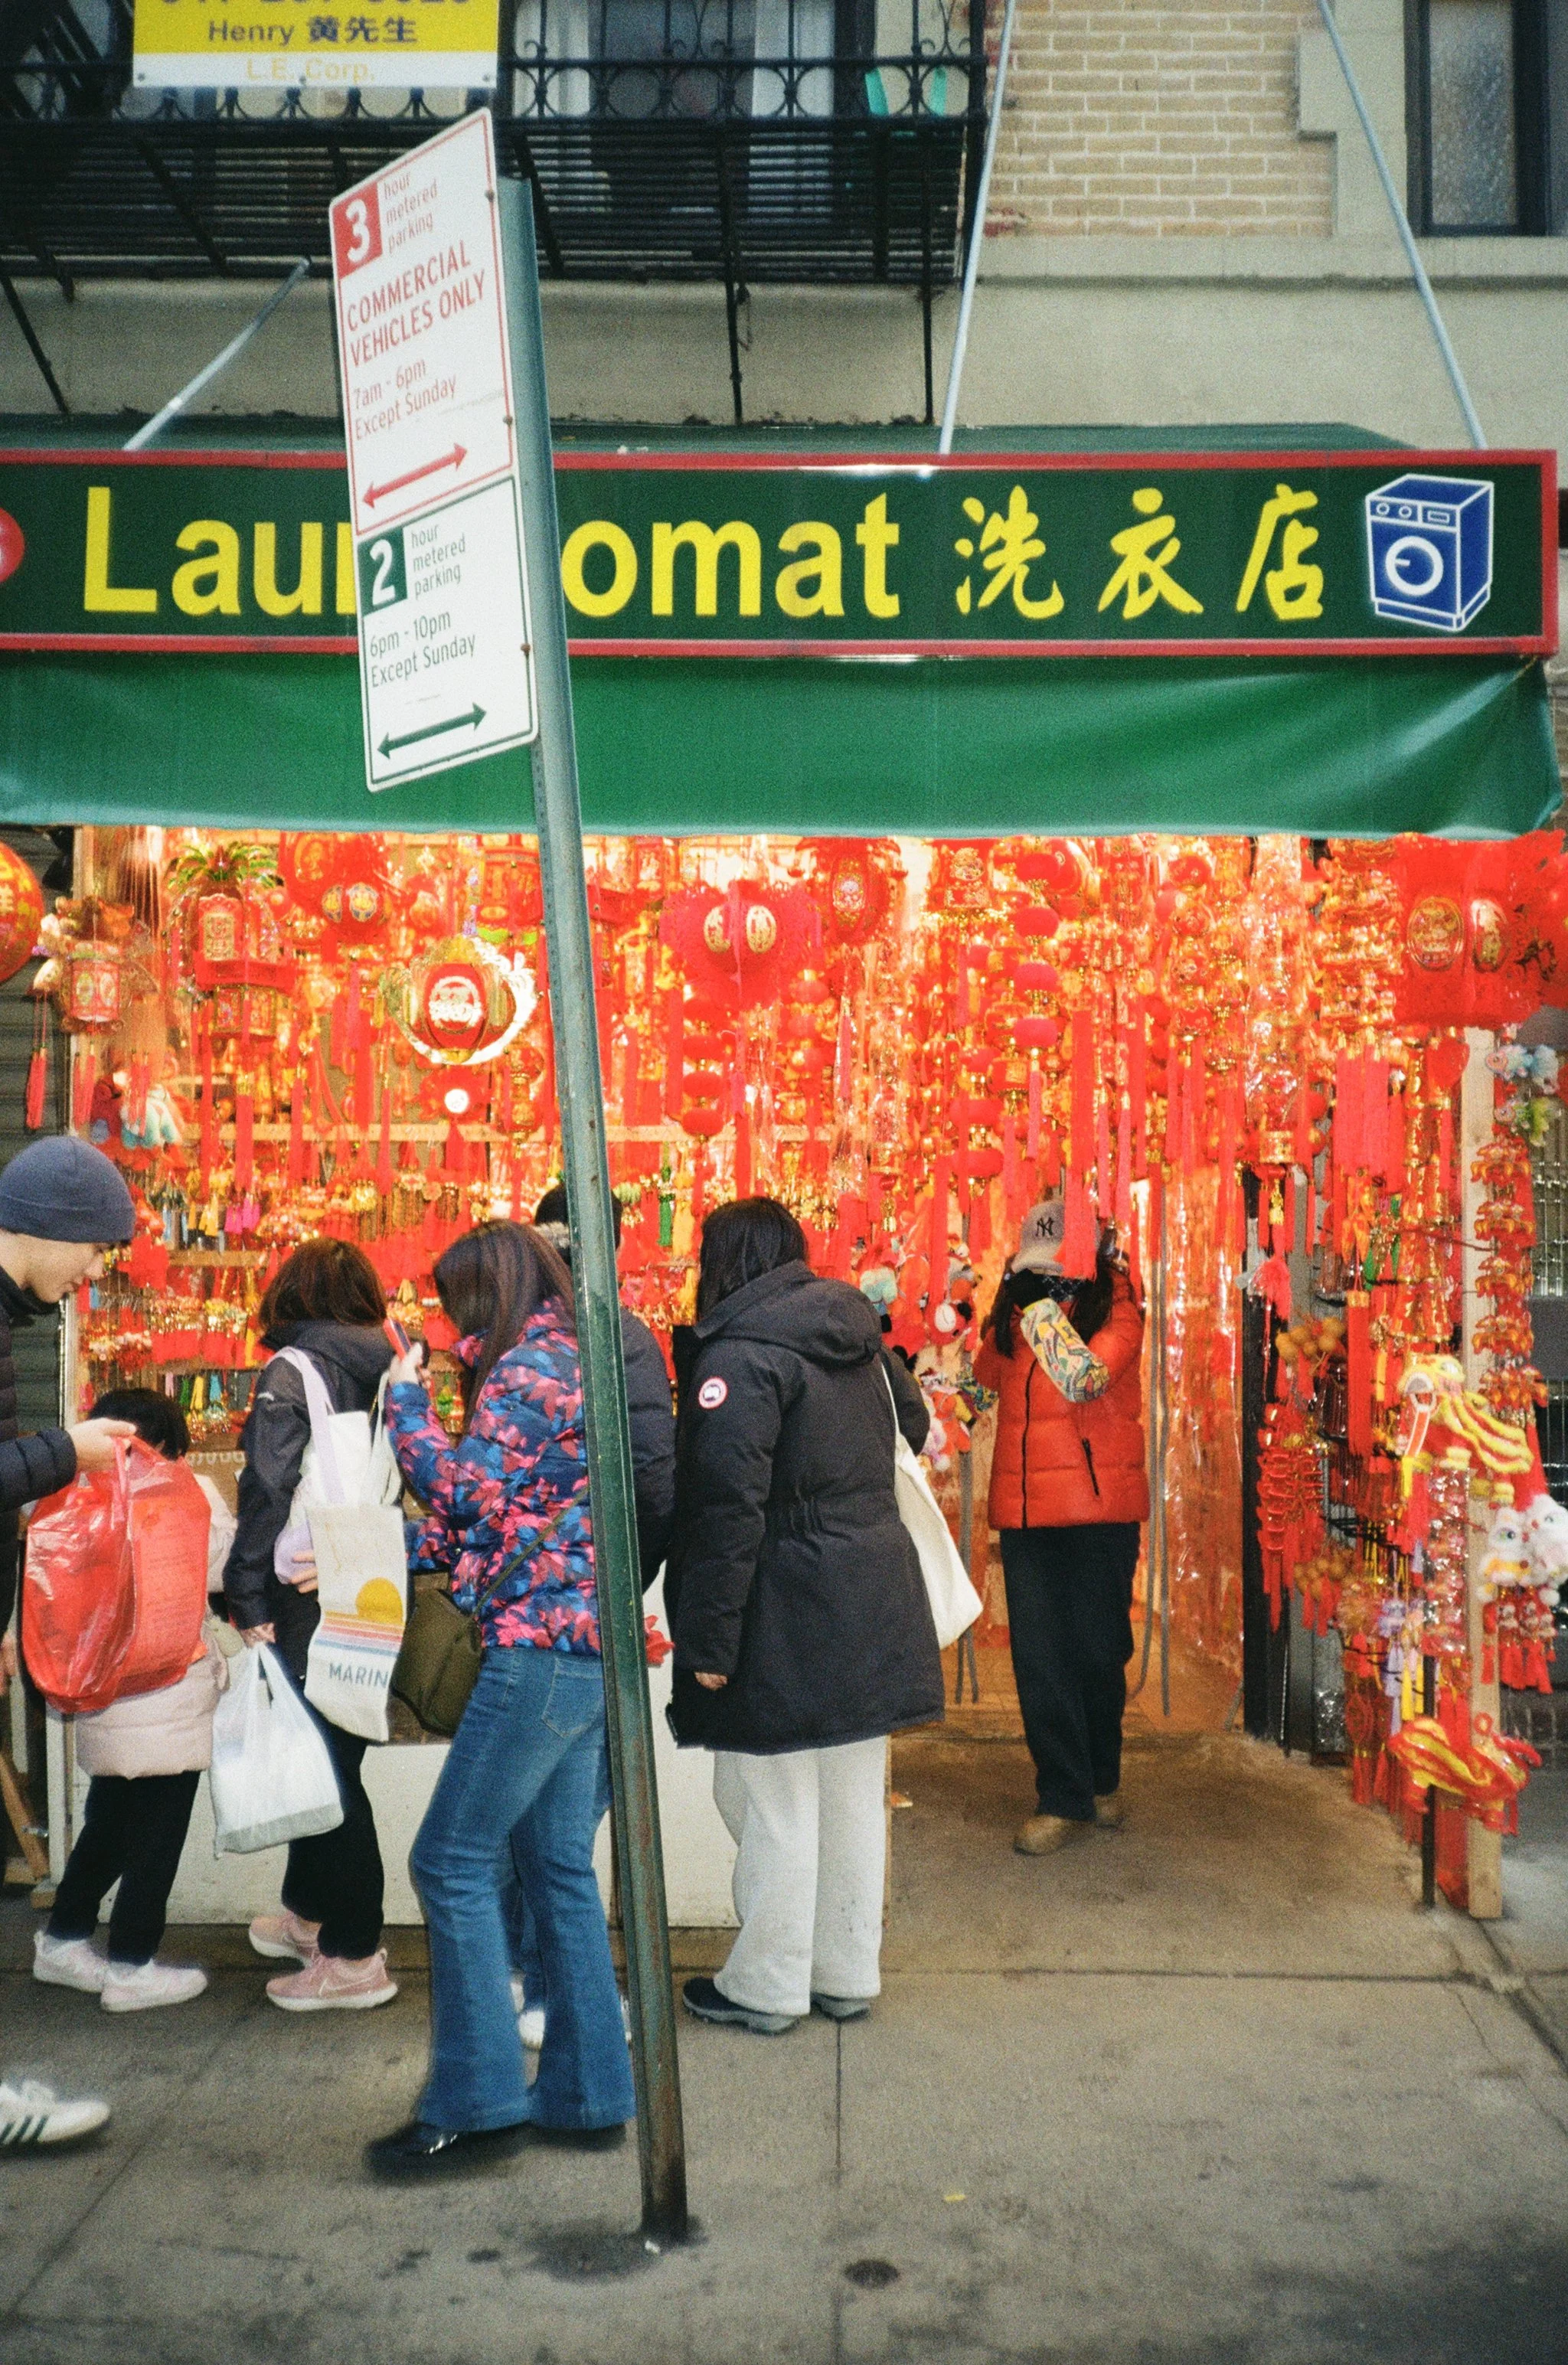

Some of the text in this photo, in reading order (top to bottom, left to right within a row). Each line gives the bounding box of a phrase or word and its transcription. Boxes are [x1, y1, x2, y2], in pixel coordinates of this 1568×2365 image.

[208, 20, 295, 47] Henry
[247, 57, 375, 83] L.E. Corp.
[384, 173, 411, 199] hour
[385, 179, 438, 225] metered
[346, 198, 372, 264] 3
[387, 212, 434, 255] parking
[347, 240, 471, 332] COMMERCIAL
[350, 269, 487, 368] VEHICLES ONLY
[353, 380, 383, 410] 7am
[395, 358, 426, 394] 6pm
[355, 397, 400, 441] Except
[404, 374, 457, 413] Sunday
[84, 484, 1326, 622] Lauomat 洗衣店
[411, 523, 439, 549] hour
[413, 536, 466, 573] metered
[369, 539, 396, 607] 2
[414, 563, 462, 600] parking
[370, 631, 400, 661] 6pm
[413, 612, 451, 642] 10pm
[371, 633, 476, 688] Except Sunday
[1036, 1217, 1054, 1237] NY
[329, 1663, 388, 1688] MARIN
